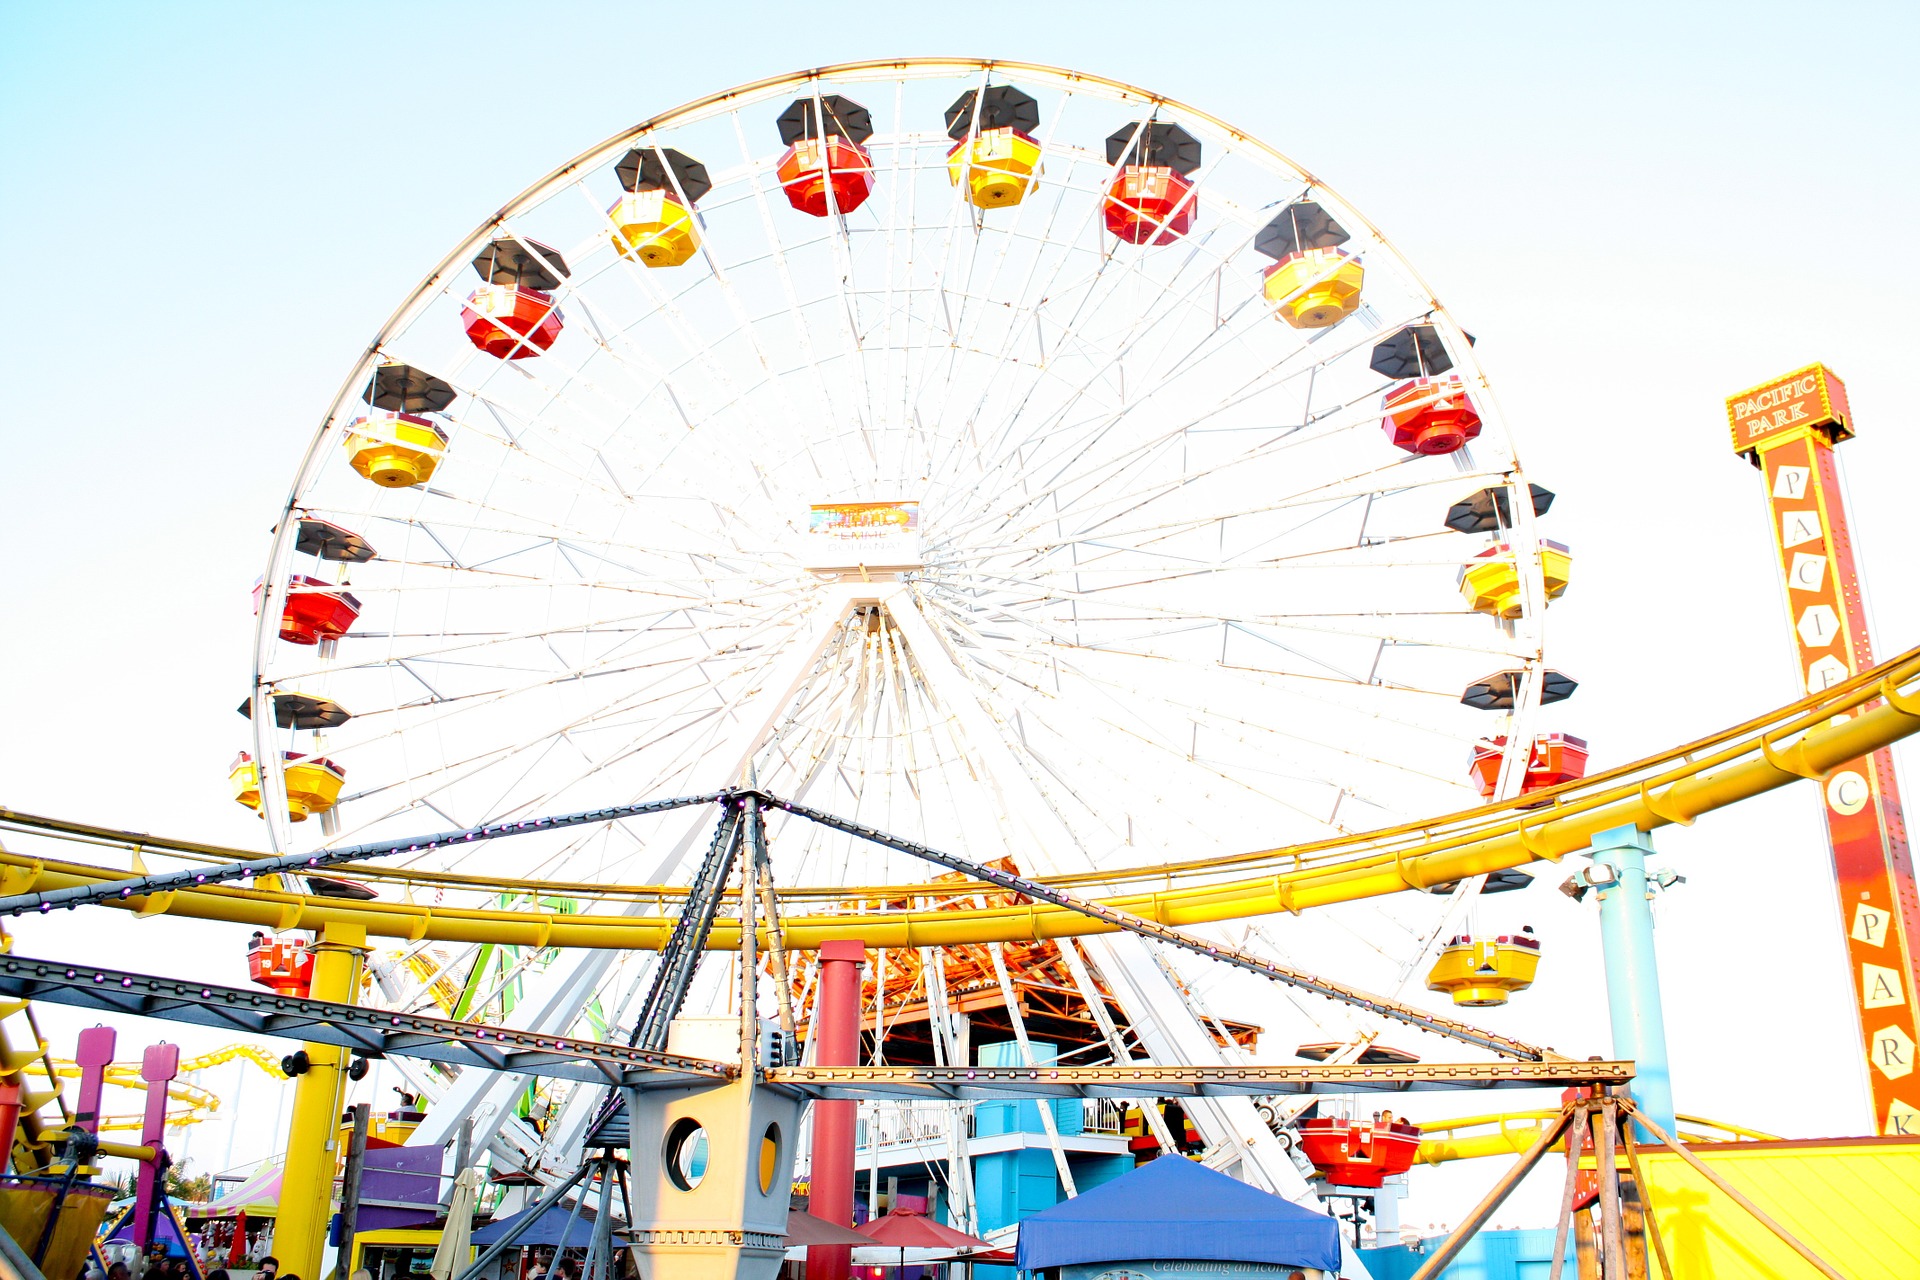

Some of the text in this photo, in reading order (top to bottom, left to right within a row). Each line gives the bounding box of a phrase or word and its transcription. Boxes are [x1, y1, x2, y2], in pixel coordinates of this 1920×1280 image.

[1733, 374, 1817, 421] PACIFIC
[1746, 401, 1809, 438] PARK
[1786, 471, 1914, 1136] PACIFC PARK
[261, 959, 272, 969] 19
[1341, 1142, 1348, 1153] 5
[1152, 1260, 1230, 1276] Celebrating
[1234, 1263, 1251, 1273] an
